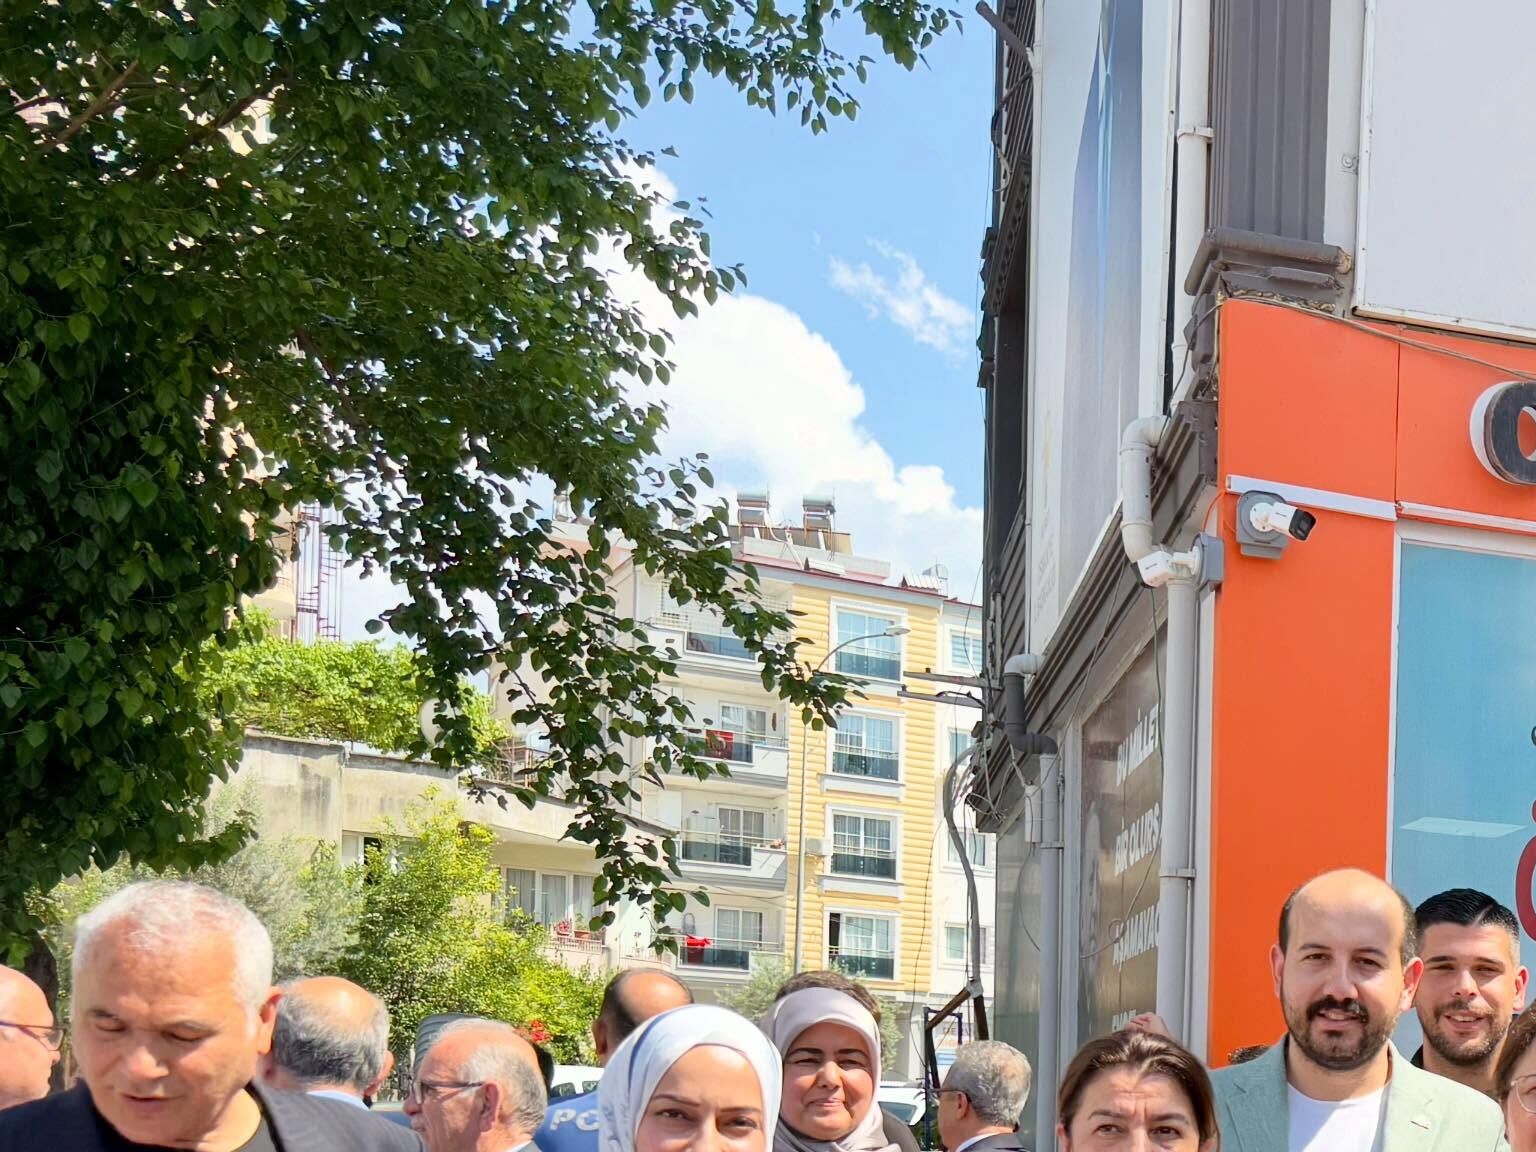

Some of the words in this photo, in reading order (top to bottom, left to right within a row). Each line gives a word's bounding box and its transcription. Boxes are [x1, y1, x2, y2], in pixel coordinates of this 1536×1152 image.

[1116, 737, 1128, 787] BU
[1115, 815, 1128, 877] BİR
[1129, 802, 1161, 867] OLURS
